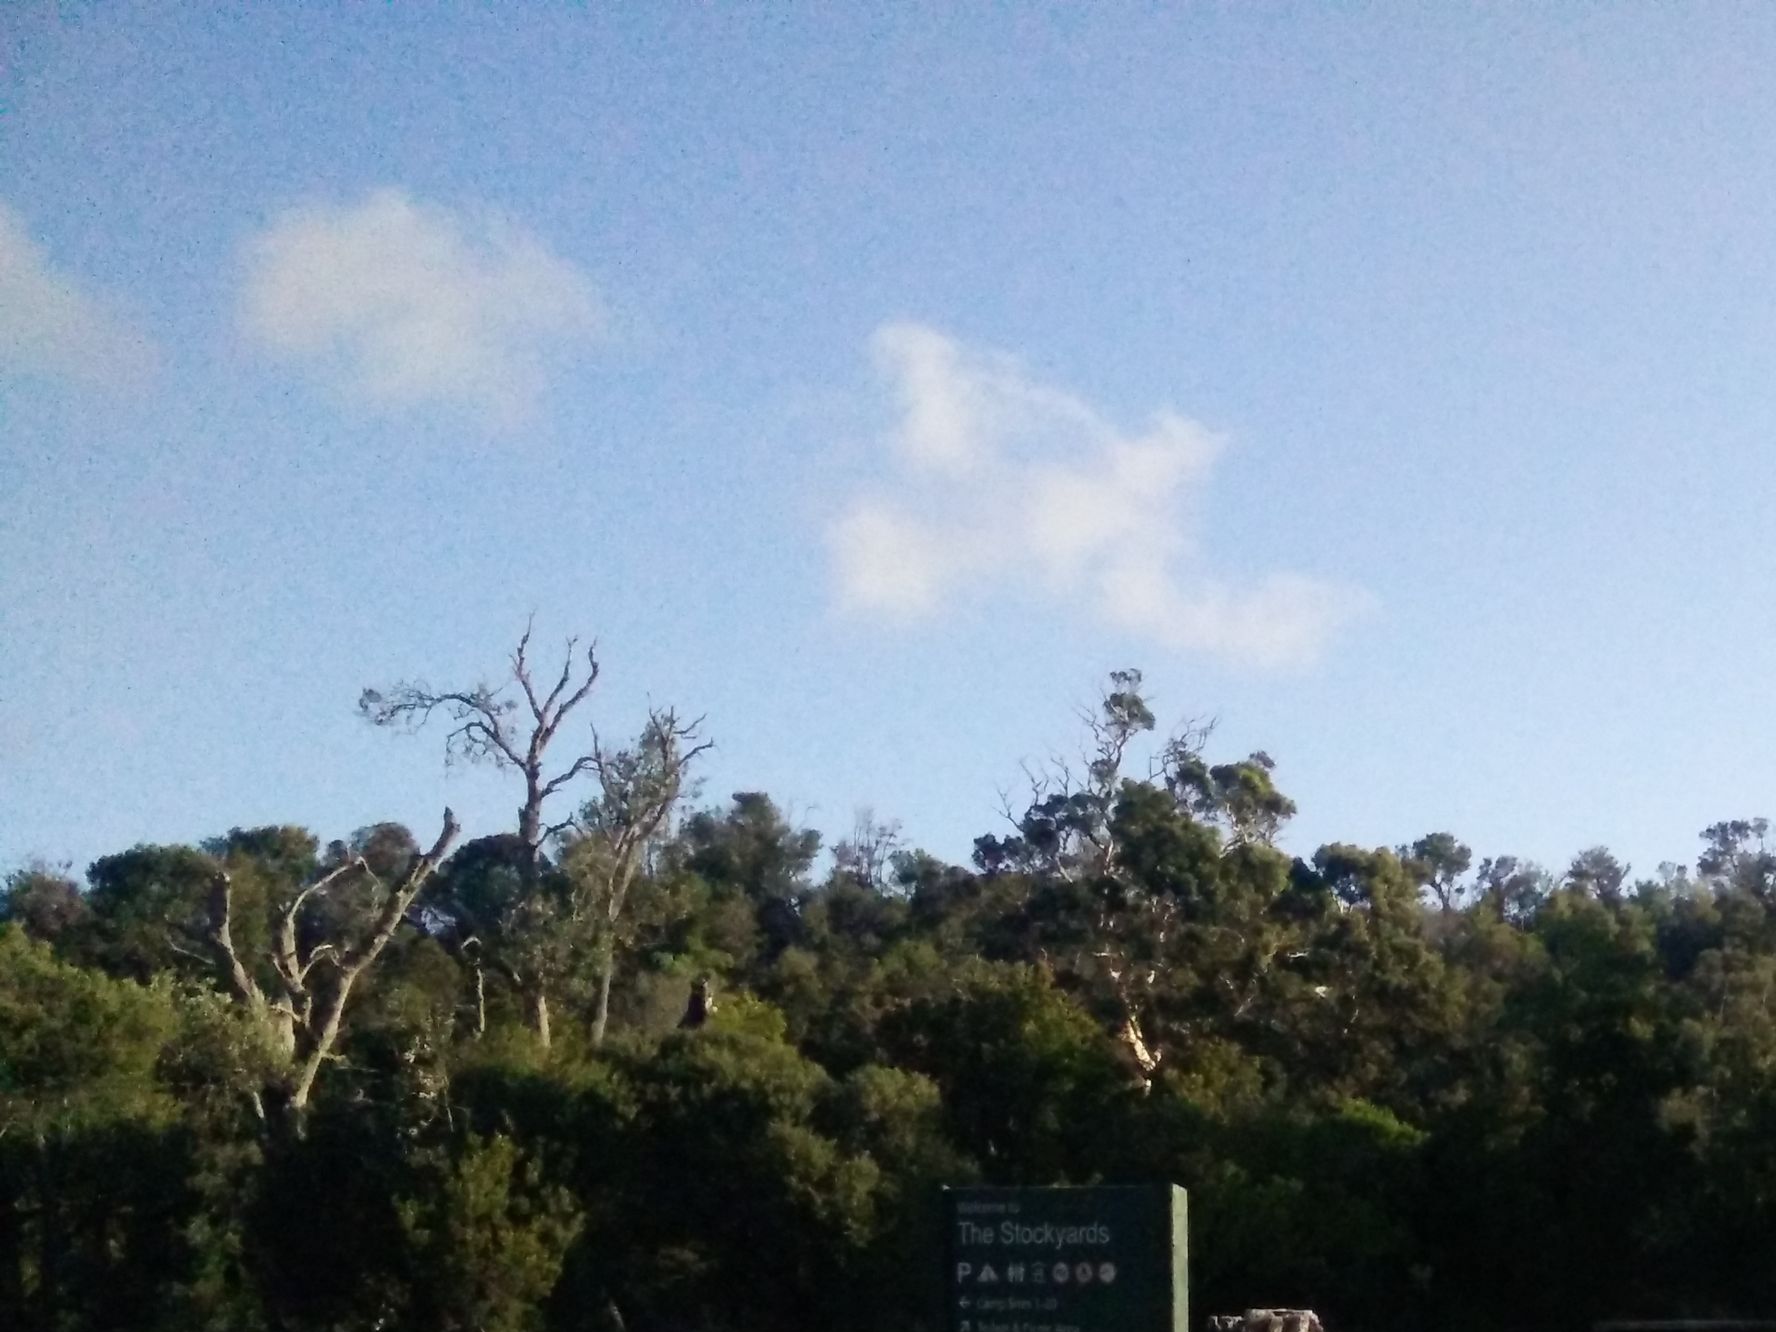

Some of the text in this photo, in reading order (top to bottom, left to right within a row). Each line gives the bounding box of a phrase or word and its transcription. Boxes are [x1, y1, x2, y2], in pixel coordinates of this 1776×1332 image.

[957, 1220, 1110, 1250] The Stockyards
[957, 1262, 972, 1284] P
